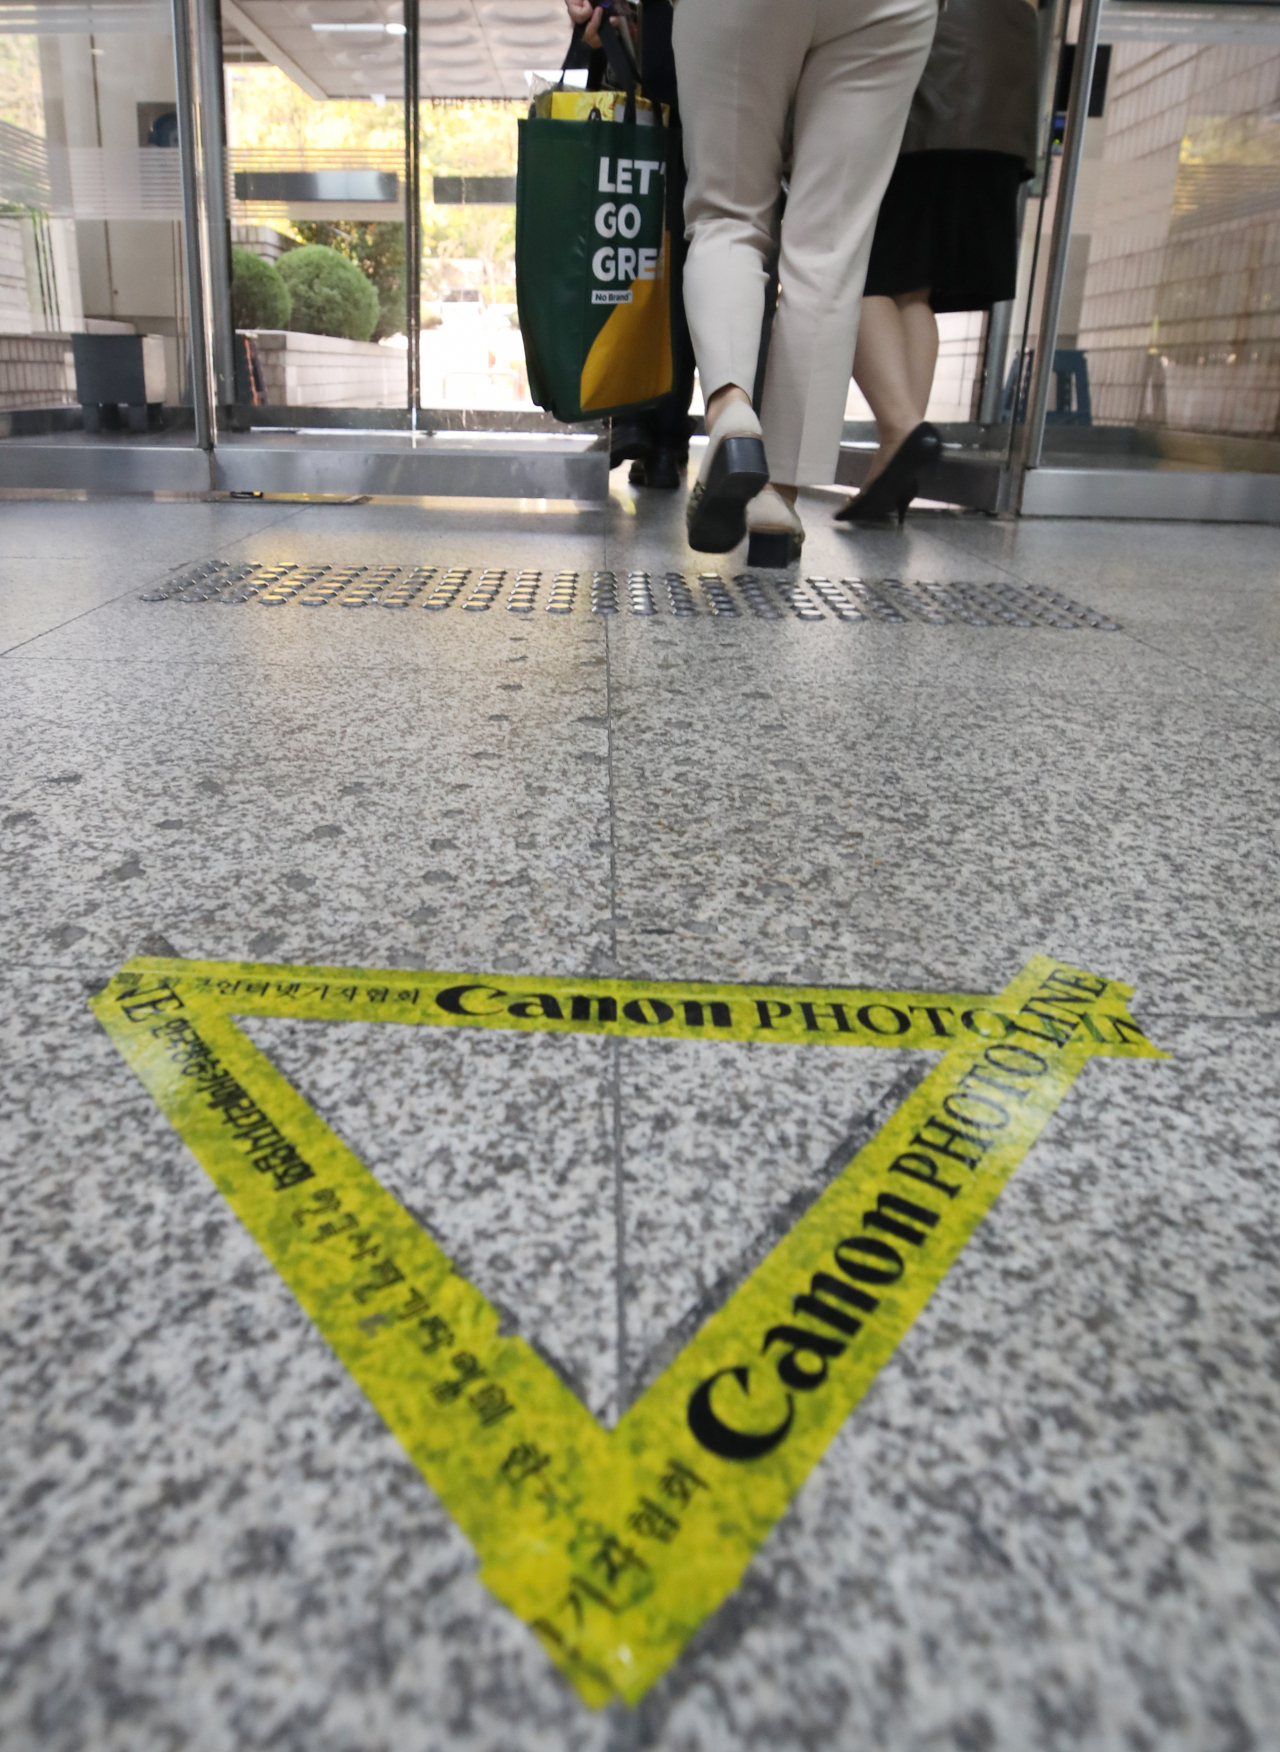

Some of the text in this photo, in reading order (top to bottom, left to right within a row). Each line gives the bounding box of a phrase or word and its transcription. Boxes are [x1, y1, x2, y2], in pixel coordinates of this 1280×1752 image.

[594, 202, 642, 239] GO
[595, 292, 607, 301] No
[434, 983, 733, 1028] Canon
[752, 999, 1017, 1041] PHOTO
[686, 1191, 941, 1463] Canon
[887, 1042, 1049, 1200] PHOTO
[1005, 967, 1109, 1049] LINE
